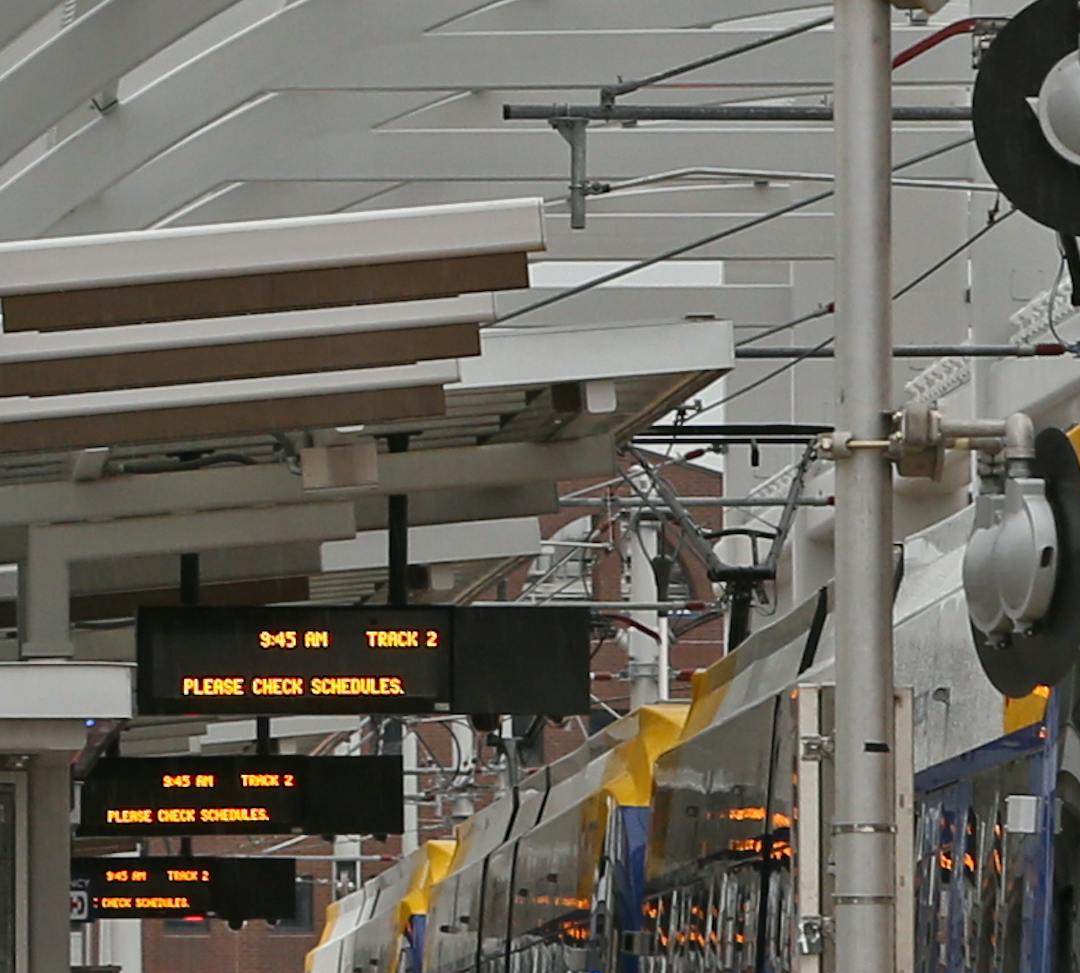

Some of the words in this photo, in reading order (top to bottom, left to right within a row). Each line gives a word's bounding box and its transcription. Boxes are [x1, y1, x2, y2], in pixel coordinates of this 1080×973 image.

[259, 630, 297, 648] 9:45
[304, 630, 329, 648] AM
[366, 630, 419, 648] TRACK
[426, 630, 438, 647] 2
[183, 678, 245, 696] PLEASE
[252, 677, 304, 695] CHECK
[311, 677, 405, 695] SCHEDULES.
[162, 774, 191, 788] 9:45
[195, 774, 215, 788] AM
[240, 773, 280, 787] TRACK
[284, 773, 295, 787] 2
[106, 809, 153, 823] PLEASE
[157, 808, 196, 823] CHECK
[200, 807, 270, 822] SCHEDULES.
[167, 869, 198, 882] TRACK
[201, 869, 210, 882] 2
[101, 897, 132, 909] CHECK
